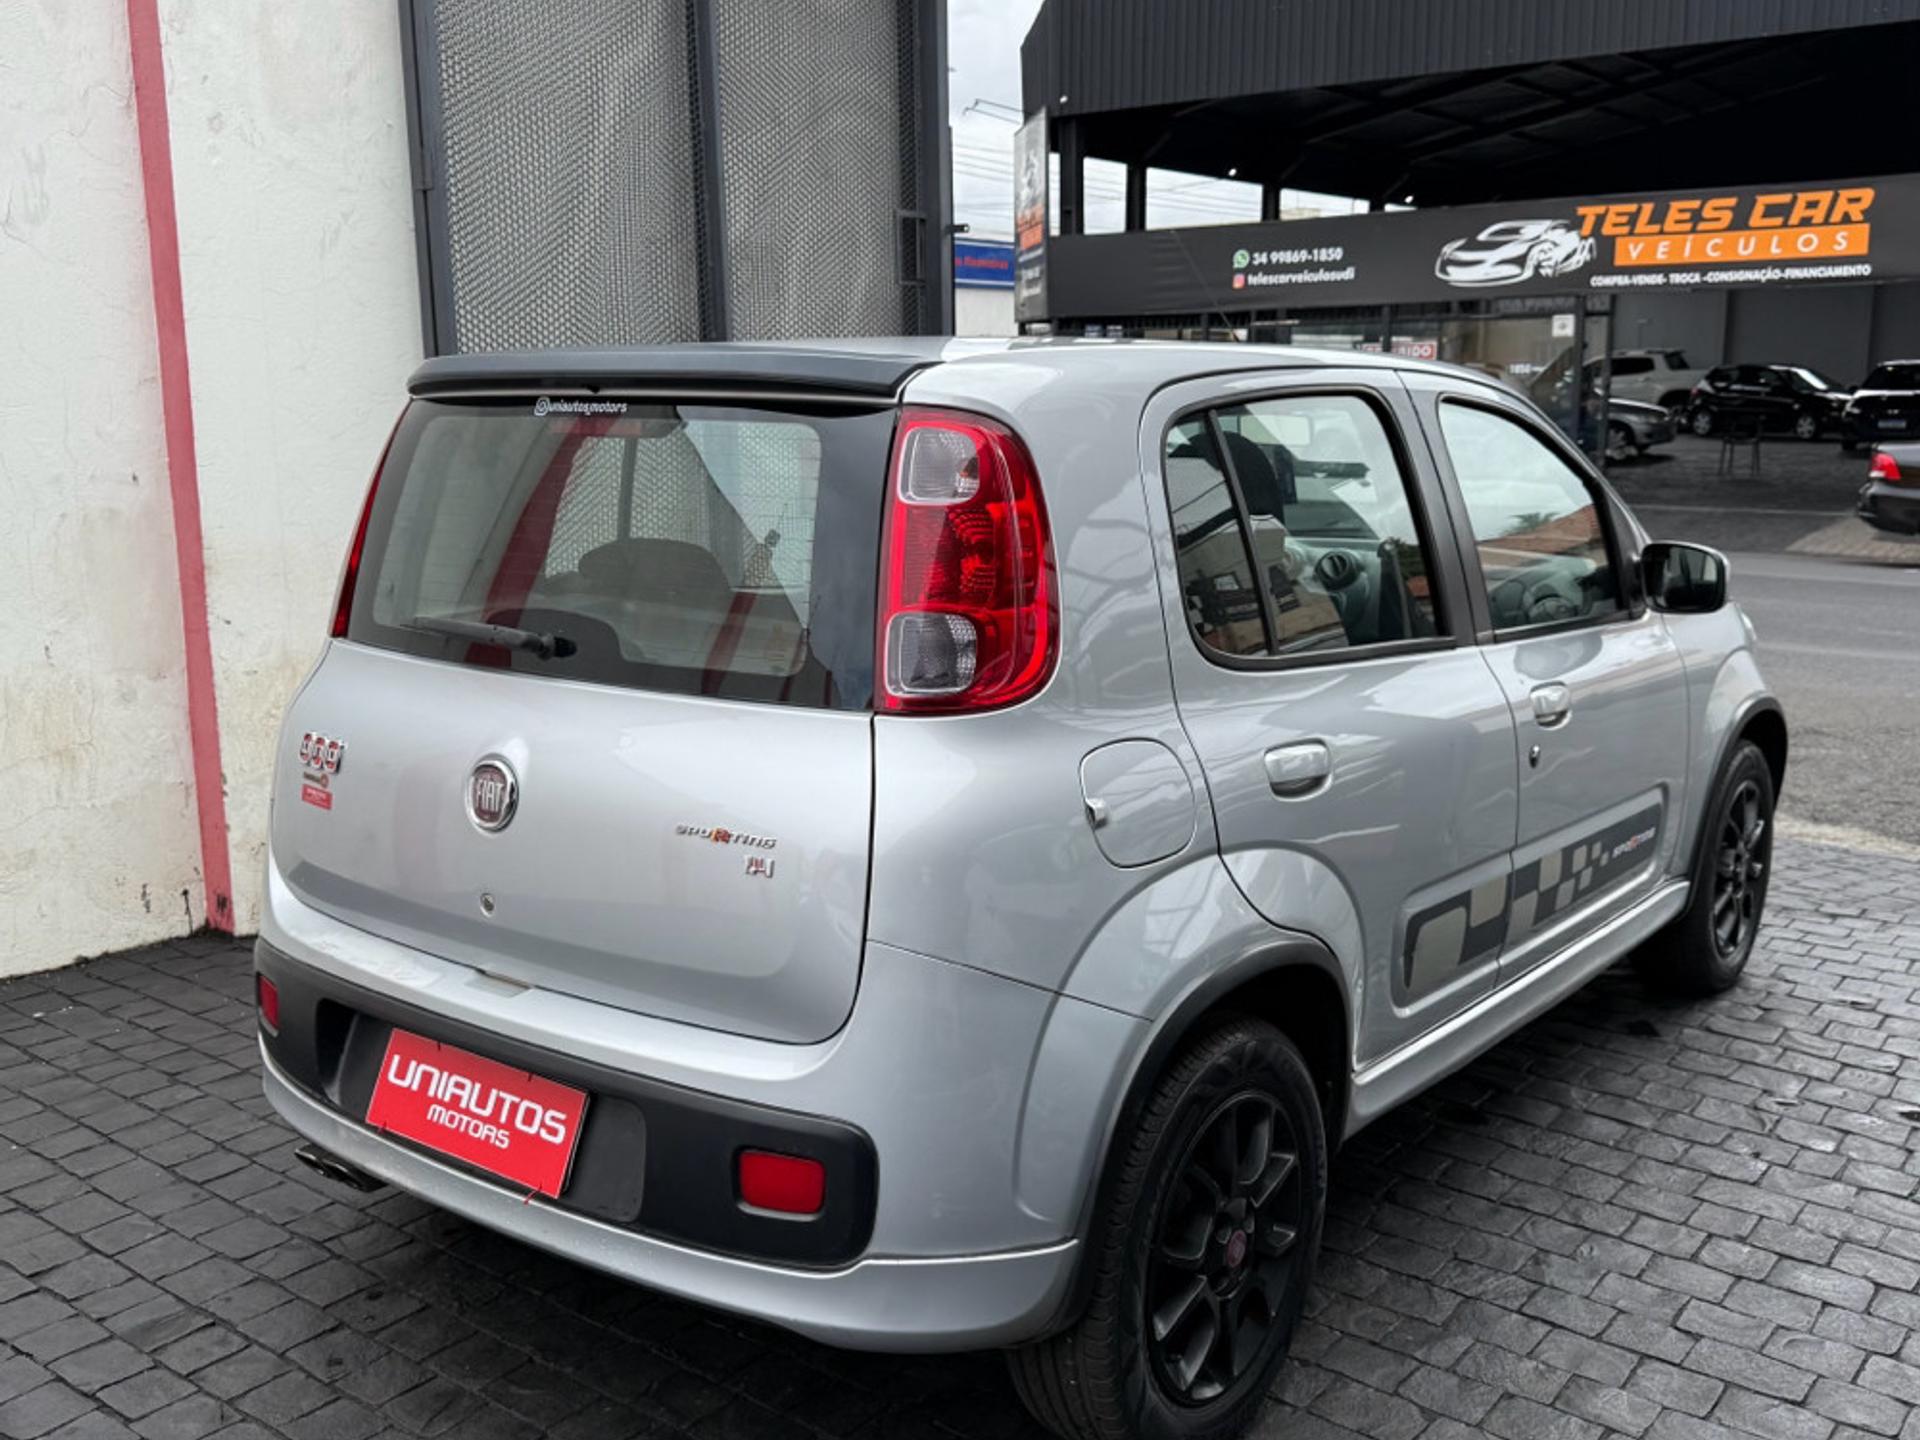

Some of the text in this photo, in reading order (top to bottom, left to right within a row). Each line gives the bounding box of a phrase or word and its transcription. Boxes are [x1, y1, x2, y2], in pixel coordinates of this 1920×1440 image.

[1576, 187, 1876, 237] TELES CAR
[1252, 246, 1343, 266] 34 99869-1850
[1628, 231, 1848, 261] VEÍCULOS
[476, 779, 505, 812] FIAT
[387, 1054, 567, 1145] UNIAUTOS
[427, 1104, 511, 1150] MOTORS
